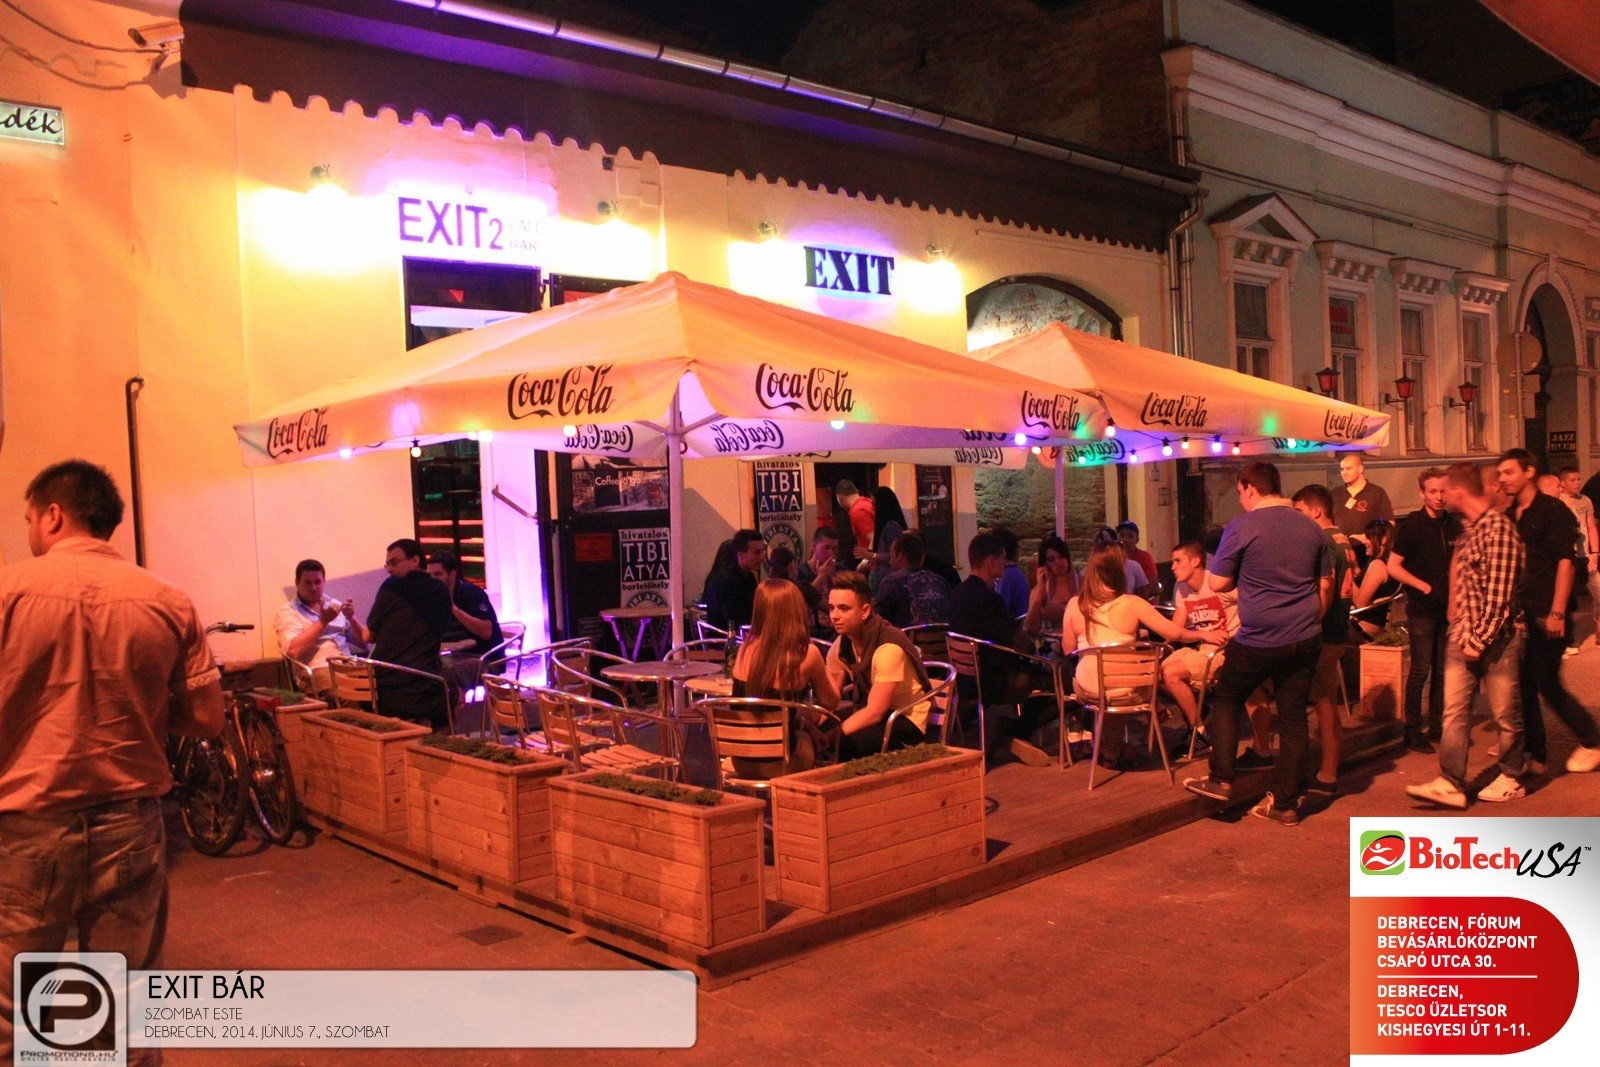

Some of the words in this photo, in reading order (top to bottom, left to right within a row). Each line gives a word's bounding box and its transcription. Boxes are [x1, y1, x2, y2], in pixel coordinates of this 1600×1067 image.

[803, 245, 895, 296] EXIT
[507, 363, 615, 420] Coca-Cola
[755, 362, 856, 412] Coca-Cola
[1021, 390, 1081, 431] Coca-Cola
[1141, 391, 1208, 428] Coca-Cola
[1323, 409, 1369, 440] Coca-Cola
[266, 406, 329, 458] Coca-Cola
[595, 475, 619, 486] Coffee
[757, 471, 800, 493] TIBI
[759, 494, 801, 511] ATYA
[622, 541, 668, 563] TIBI
[623, 563, 668, 581] ATYA
